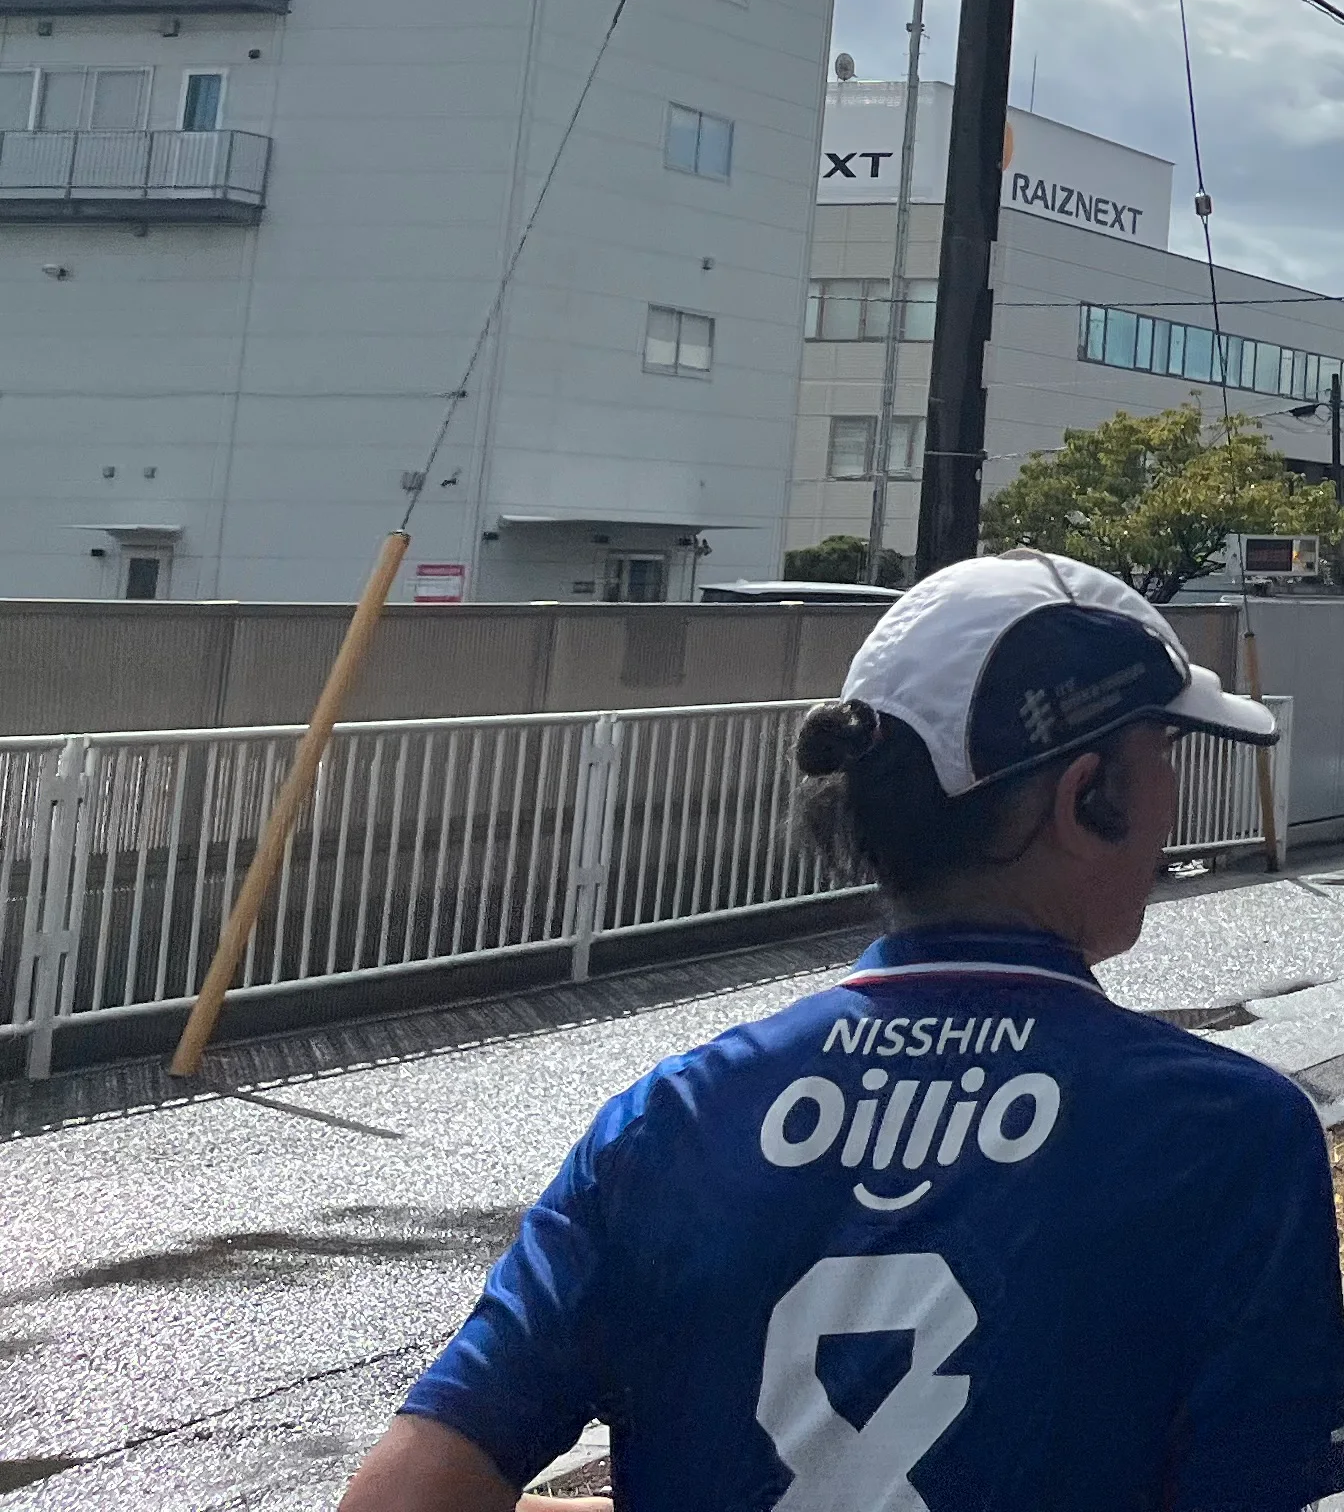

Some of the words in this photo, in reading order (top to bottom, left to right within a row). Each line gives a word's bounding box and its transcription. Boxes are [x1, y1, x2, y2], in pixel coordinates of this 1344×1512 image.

[1012, 172, 1143, 235] RAIZNEXT
[823, 1017, 1035, 1057] NISSHIN
[756, 1252, 979, 1512] 8
